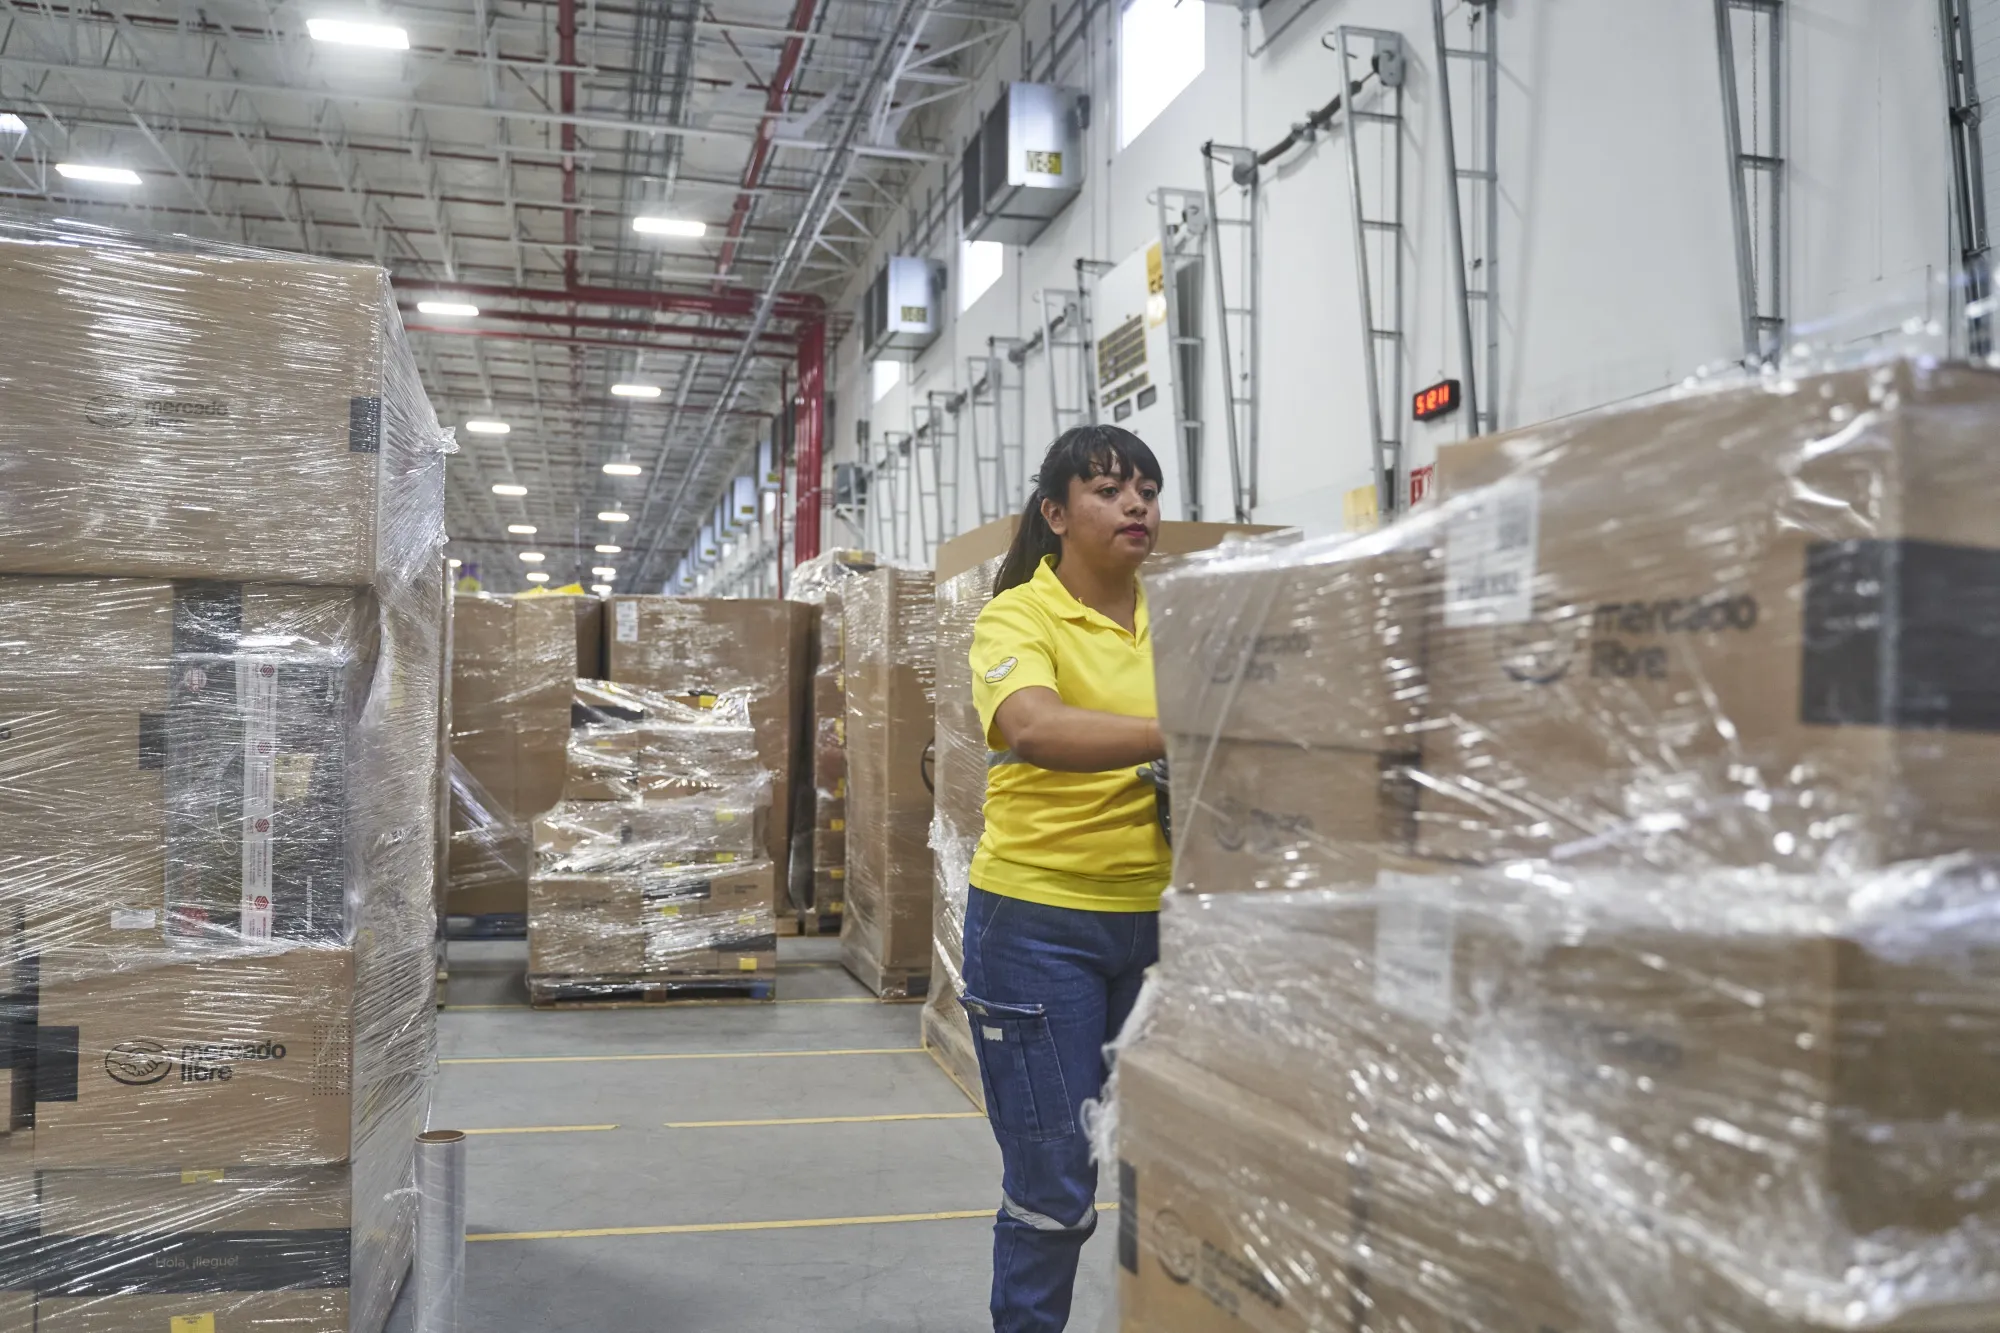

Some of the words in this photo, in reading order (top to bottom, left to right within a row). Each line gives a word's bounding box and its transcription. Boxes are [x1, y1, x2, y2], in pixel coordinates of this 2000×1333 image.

[145, 400, 229, 416] mercado
[182, 1040, 286, 1060] mercado
[181, 1063, 233, 1081] libre
